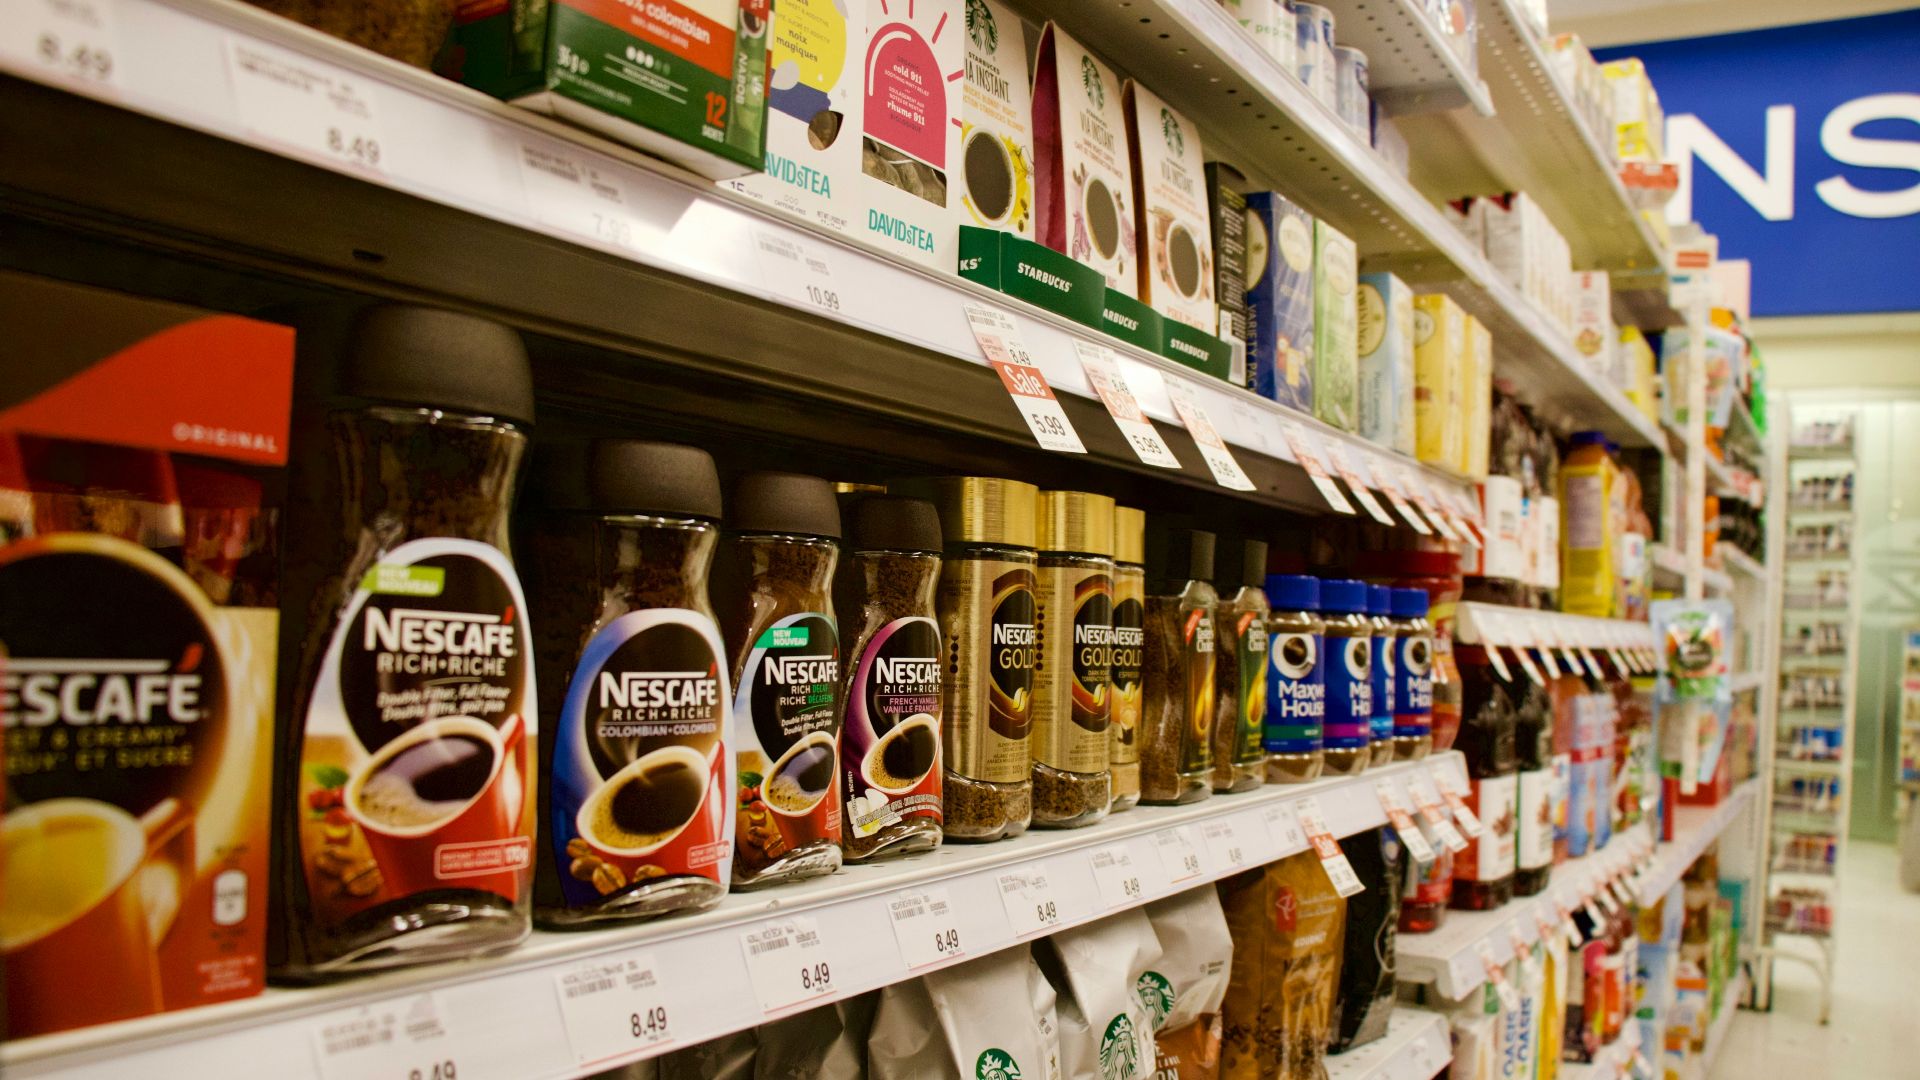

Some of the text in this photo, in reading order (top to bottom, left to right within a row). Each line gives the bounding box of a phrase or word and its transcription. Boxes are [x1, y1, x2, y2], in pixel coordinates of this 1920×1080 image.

[776, 36, 818, 62] magiques
[788, 29, 807, 45] noix
[893, 64, 922, 85] cold 911
[968, 51, 1000, 75] STARBUCKS
[965, 58, 1010, 103] IA INSTANT
[705, 91, 727, 128] 12
[887, 100, 925, 126] rhume 911
[326, 127, 380, 163] 8.49
[764, 151, 831, 200] AVIDsTEA
[1017, 262, 1071, 293] STARBUCKS
[806, 284, 840, 311] 10.99
[1102, 308, 1137, 331] ARBUCKS
[1248, 304, 1257, 353] VARIETY
[1170, 338, 1209, 362] STARBUCKS
[1003, 365, 1047, 397] Sale
[1031, 413, 1065, 437] 5.99
[171, 422, 278, 453] ORIGINAL
[1132, 434, 1163, 455] 5.99
[993, 623, 1036, 646] NESCAF
[1000, 648, 1034, 669] GOLD
[0, 644, 202, 726] ESCAFÉ
[790, 684, 811, 695] RICH
[779, 696, 807, 706] RICHE
[883, 705, 914, 714] VANILLE
[890, 697, 918, 706] FRENCH
[1123, 877, 1140, 896] 8.49
[1037, 901, 1057, 922] 8.49
[936, 928, 959, 952] 8.49
[801, 962, 830, 989] 8.49
[631, 1006, 667, 1038] 8.49
